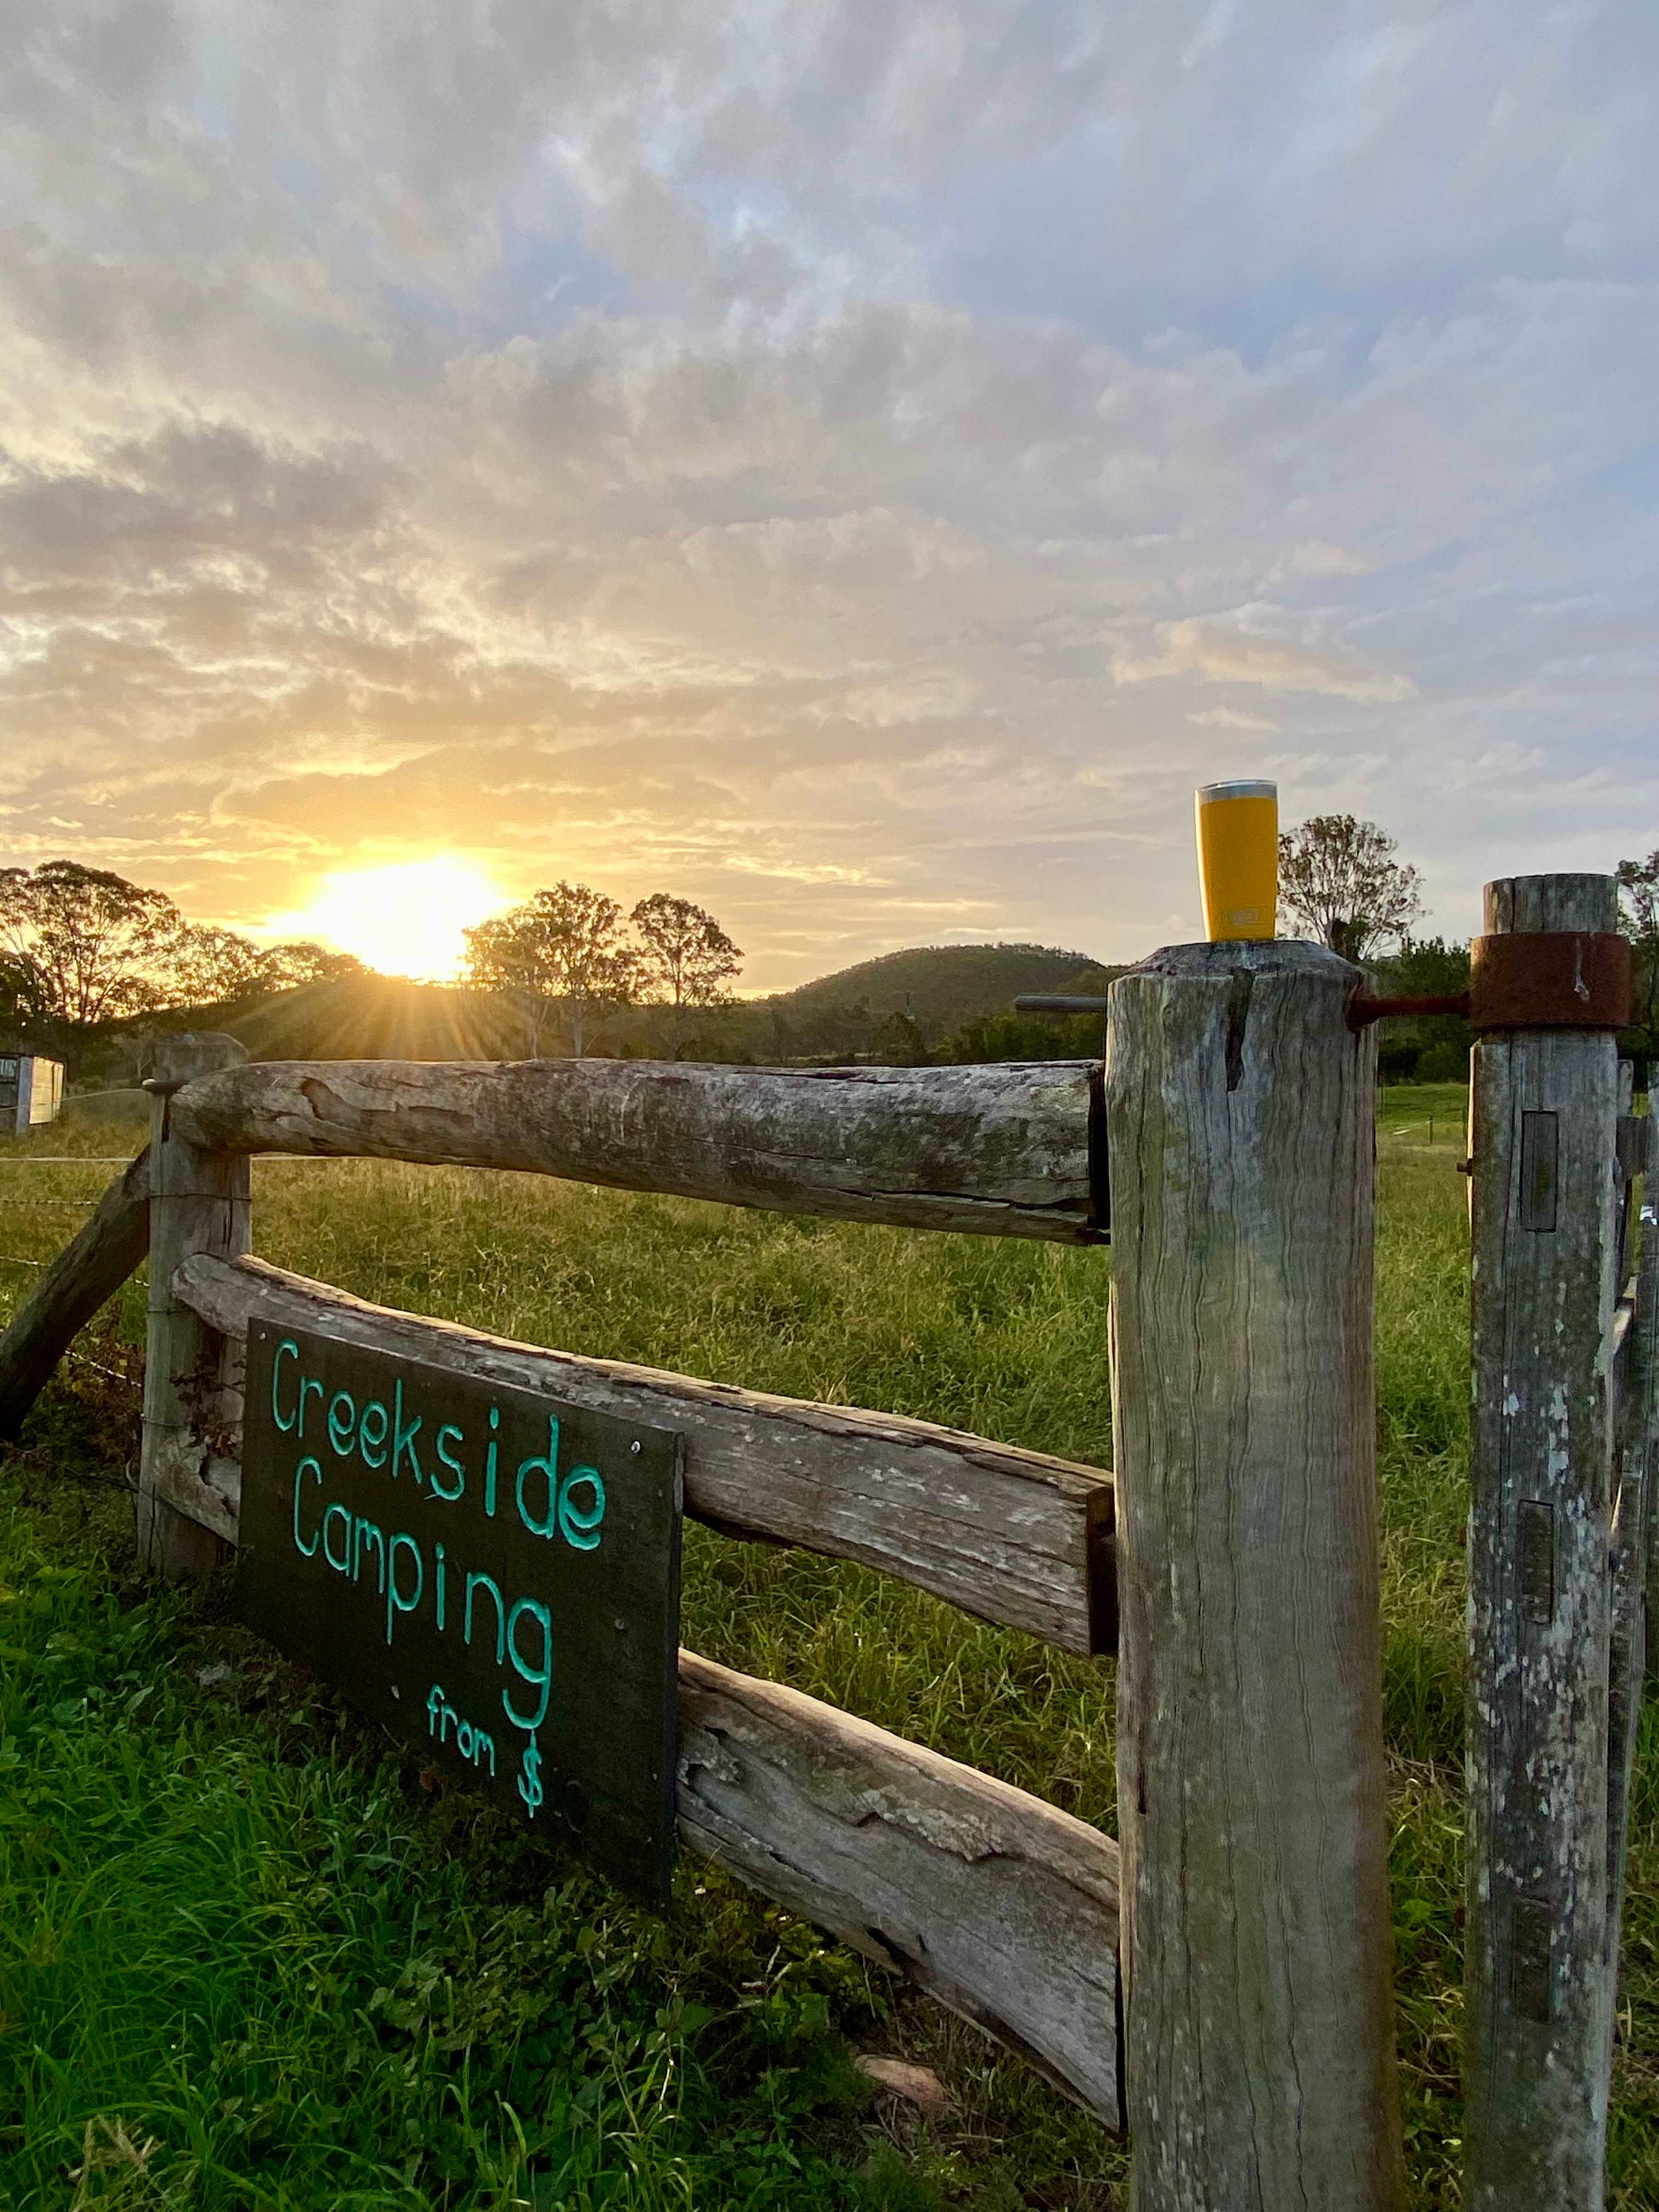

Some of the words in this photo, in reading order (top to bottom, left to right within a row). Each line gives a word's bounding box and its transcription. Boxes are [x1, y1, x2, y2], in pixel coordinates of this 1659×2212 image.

[272, 1340, 606, 1550] Creekside
[294, 1455, 552, 1730] Camping
[426, 1685, 496, 1777] from
[517, 1730, 544, 1818] $
